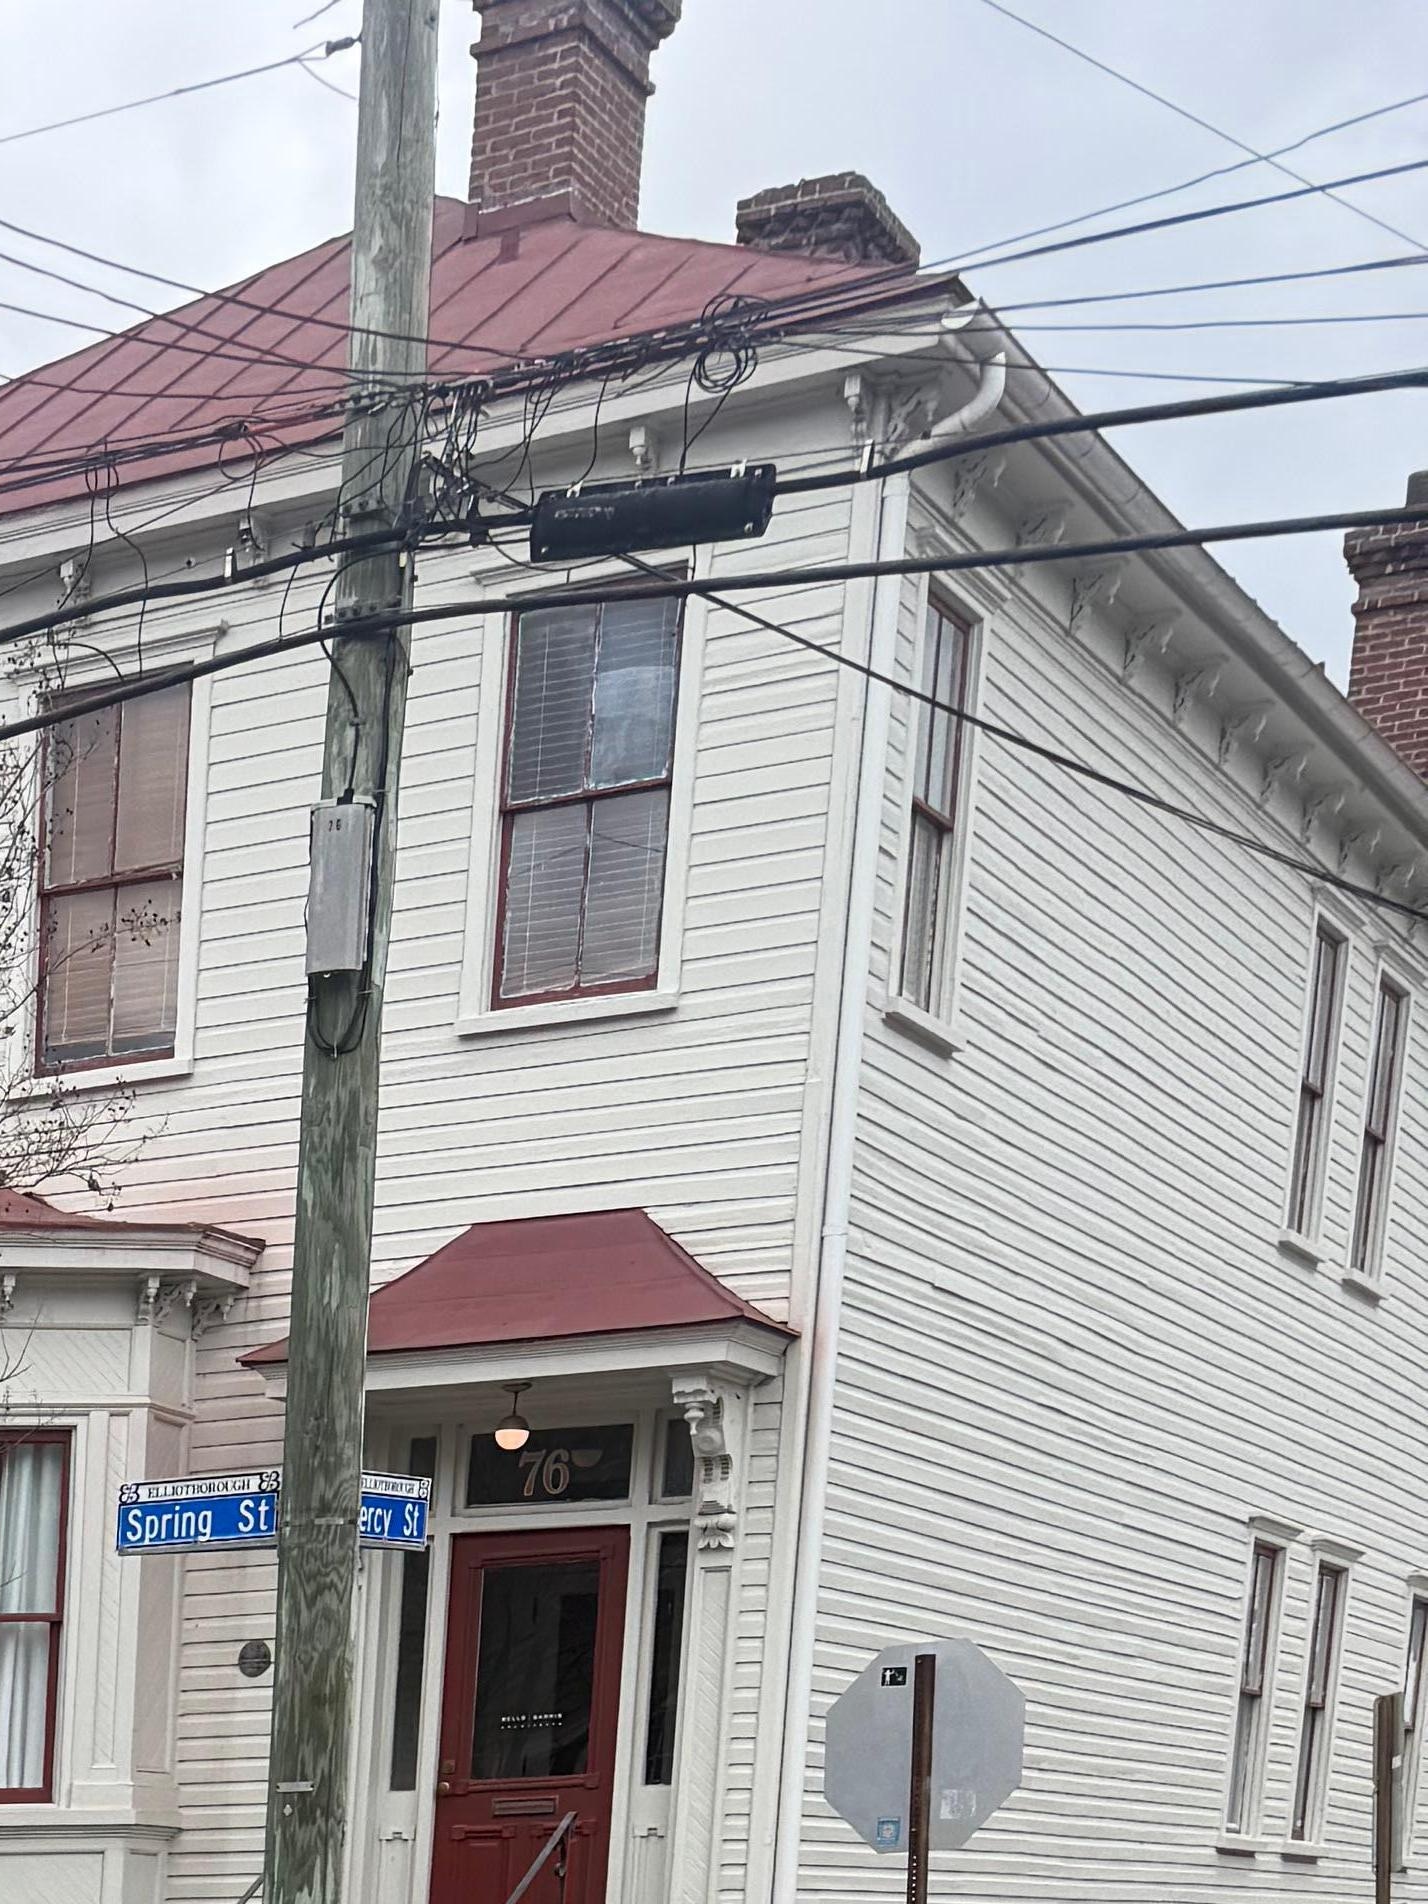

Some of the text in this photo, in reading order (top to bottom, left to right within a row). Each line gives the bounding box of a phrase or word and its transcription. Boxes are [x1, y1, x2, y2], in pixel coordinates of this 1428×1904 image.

[518, 1448, 571, 1497] 76
[126, 1499, 270, 1543] Spring St
[359, 1503, 420, 1537] ercy St
